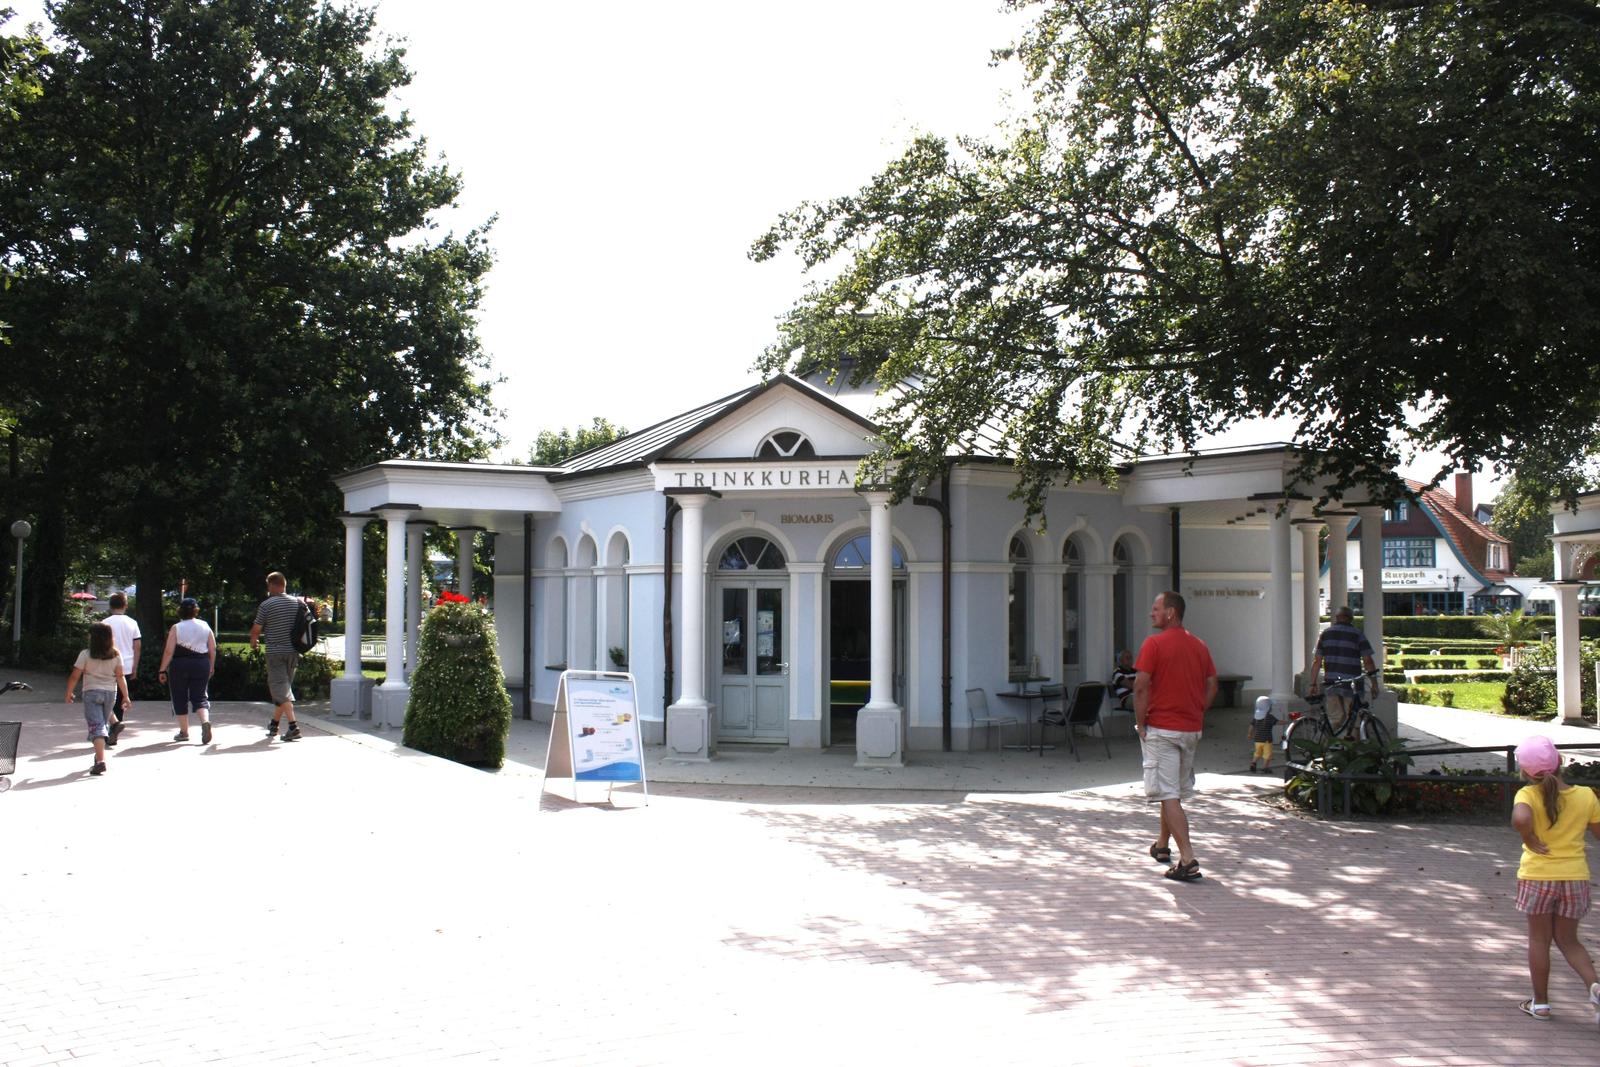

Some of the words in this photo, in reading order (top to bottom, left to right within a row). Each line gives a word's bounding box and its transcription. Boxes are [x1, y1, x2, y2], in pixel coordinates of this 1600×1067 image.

[675, 469, 895, 487] TRINKKURHALE
[781, 513, 834, 524] BIOMARIS
[1385, 570, 1426, 578] Kurpark
